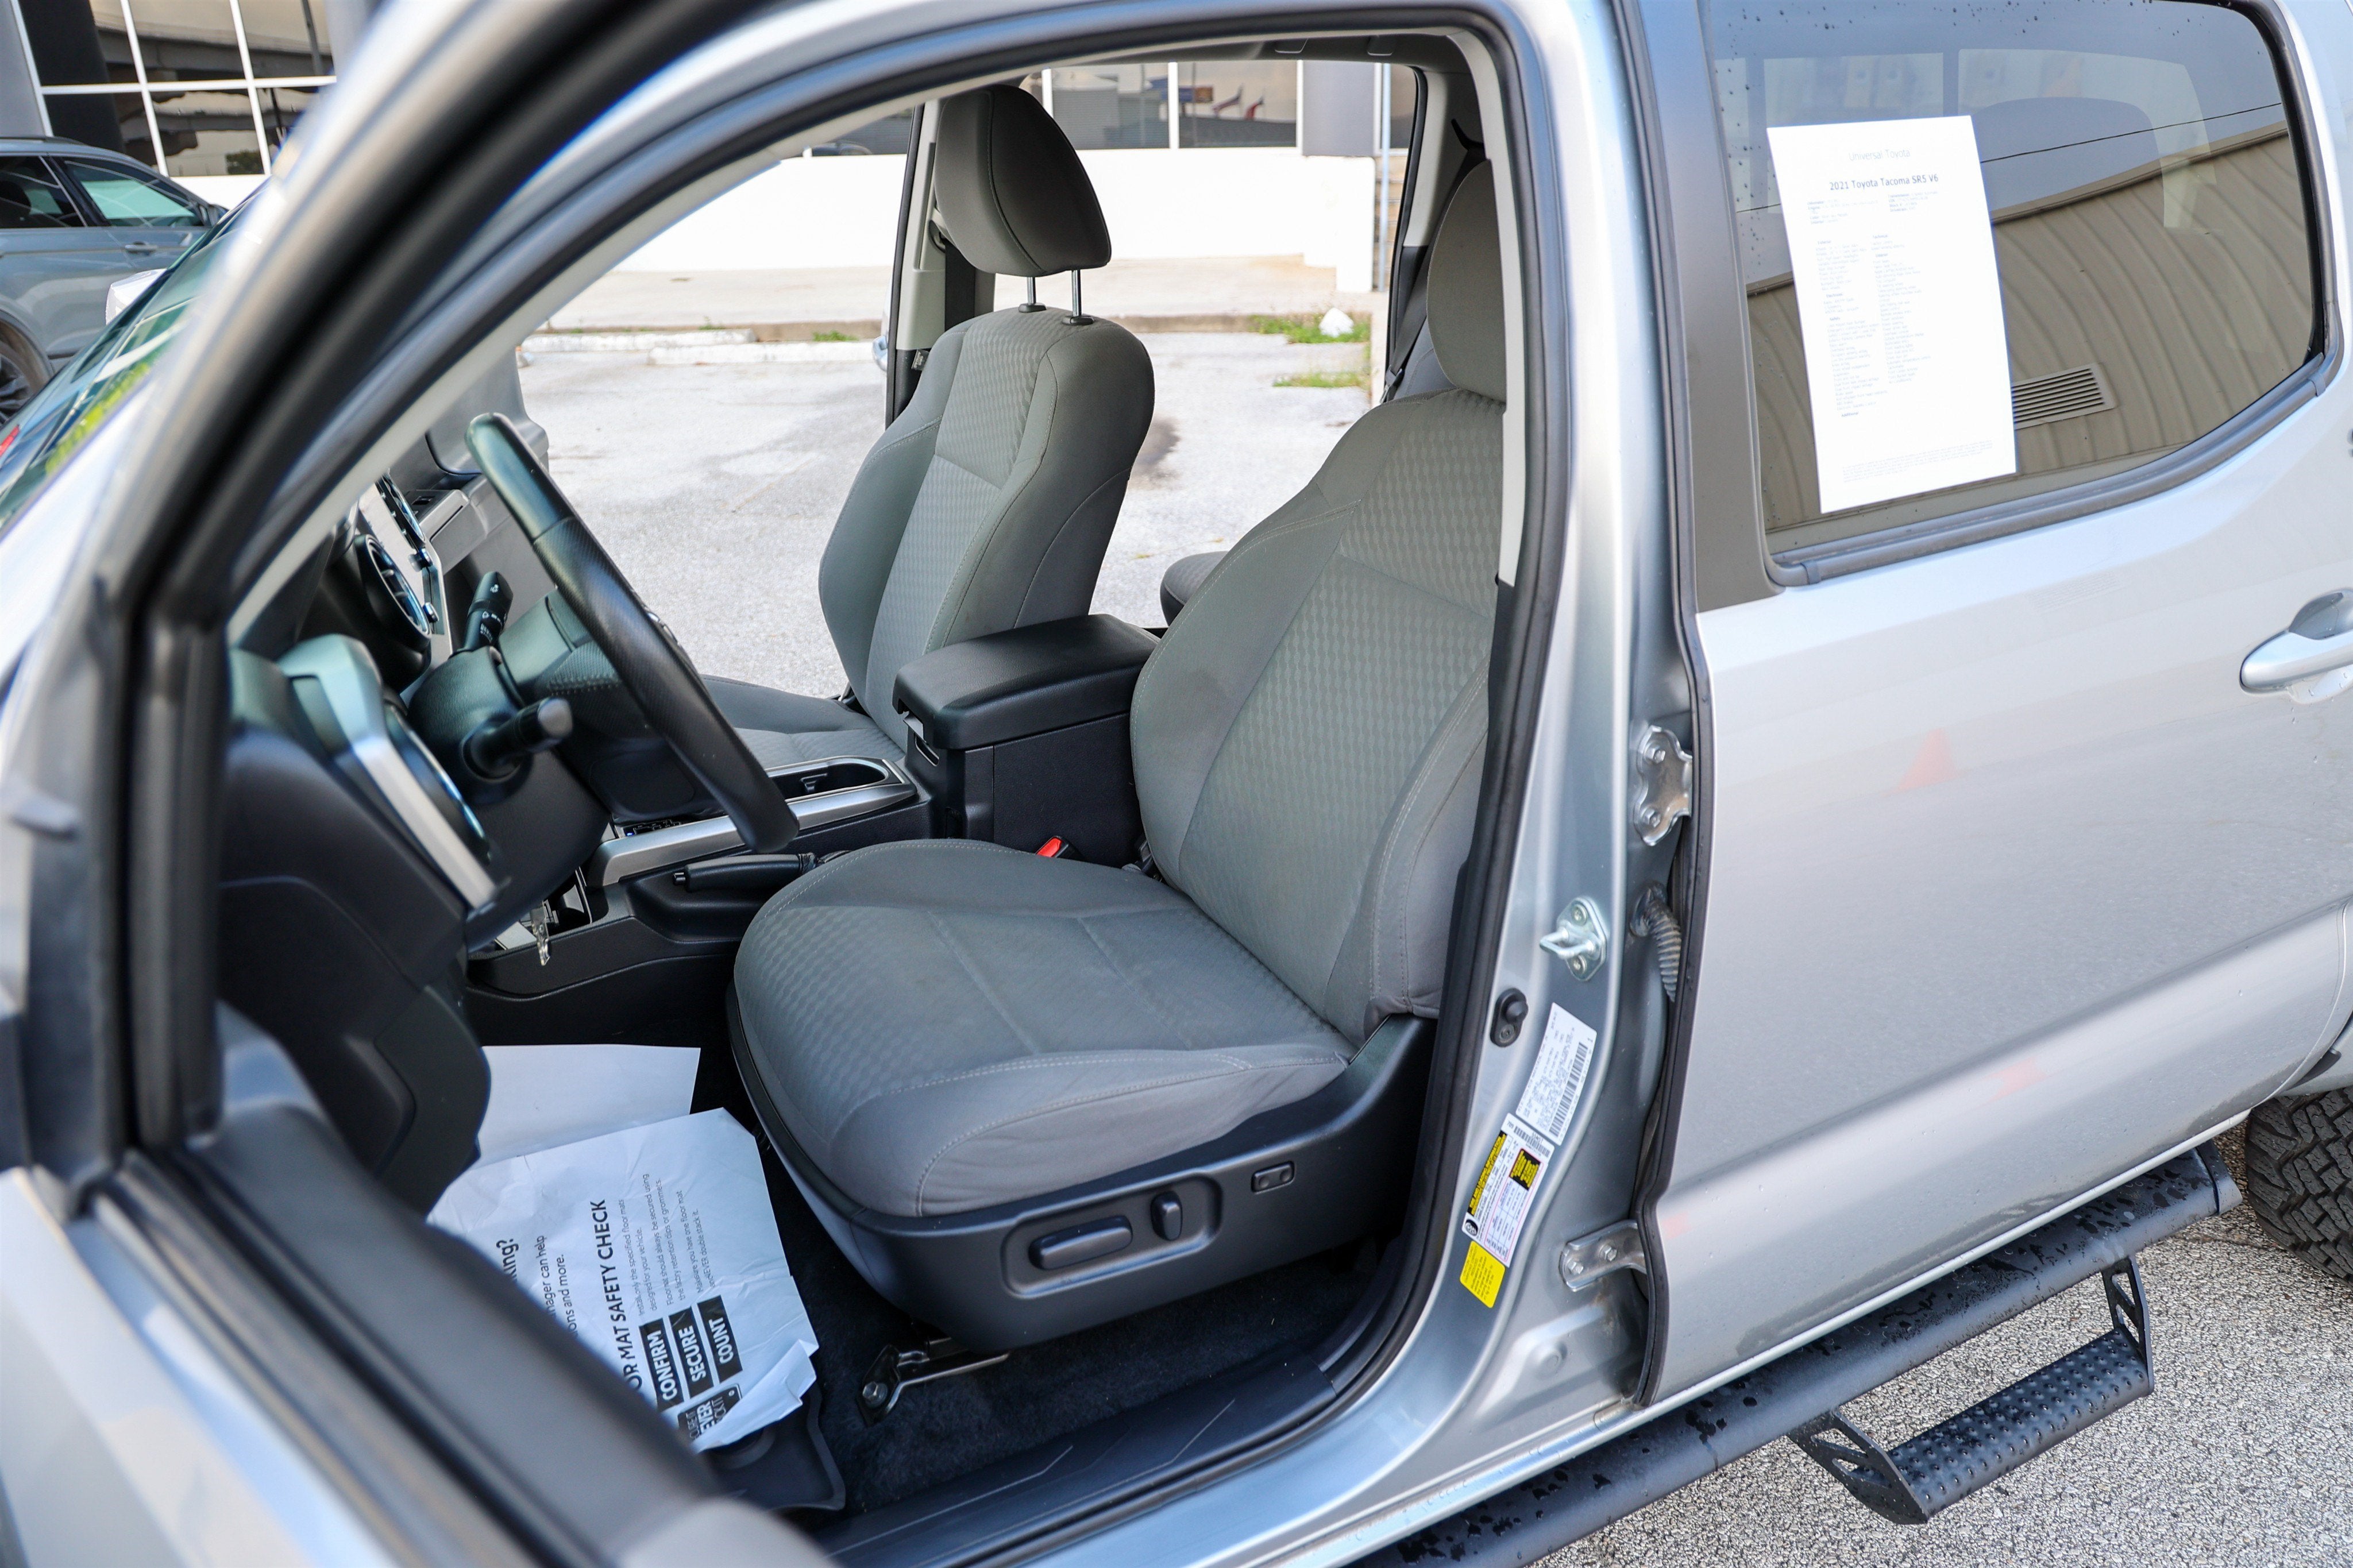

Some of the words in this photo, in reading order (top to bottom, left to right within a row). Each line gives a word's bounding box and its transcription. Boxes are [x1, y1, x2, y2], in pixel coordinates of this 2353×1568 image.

[1849, 150, 1883, 161] Universal
[1885, 149, 1911, 159] Toyota
[1829, 181, 1849, 191] 2021
[1851, 179, 1878, 190] Toyota
[1880, 177, 1910, 187] Tacoma
[1912, 174, 1927, 184] SR5
[1928, 173, 1939, 182] V6
[642, 1173, 651, 1193] using
[618, 1199, 626, 1215] mats
[645, 1194, 657, 1220] secured
[655, 1179, 669, 1215] grommets.
[676, 1190, 684, 1204] mat
[662, 1216, 669, 1224] or
[680, 1206, 688, 1223] floor
[693, 1216, 703, 1234] stack
[589, 1199, 614, 1260] CHECK
[651, 1221, 658, 1231] be
[664, 1225, 674, 1239] clips
[534, 1235, 547, 1259] help
[623, 1234, 635, 1268] specified
[636, 1227, 646, 1255] vehicle.
[654, 1231, 663, 1254] always
[697, 1234, 708, 1256] double
[641, 1256, 651, 1272] your
[657, 1254, 668, 1277] should
[667, 1239, 678, 1270] retention
[689, 1251, 699, 1264] you
[539, 1258, 550, 1279] can
[556, 1254, 568, 1287] more.
[630, 1268, 638, 1281] the
[558, 1288, 573, 1308] and
[600, 1264, 626, 1322] SAFETY
[613, 1326, 635, 1360] MAT
[708, 1317, 734, 1365] COUNT
[678, 1325, 707, 1383] SECURE
[647, 1330, 678, 1401] CONFIRM
[696, 1400, 713, 1434] EVER
